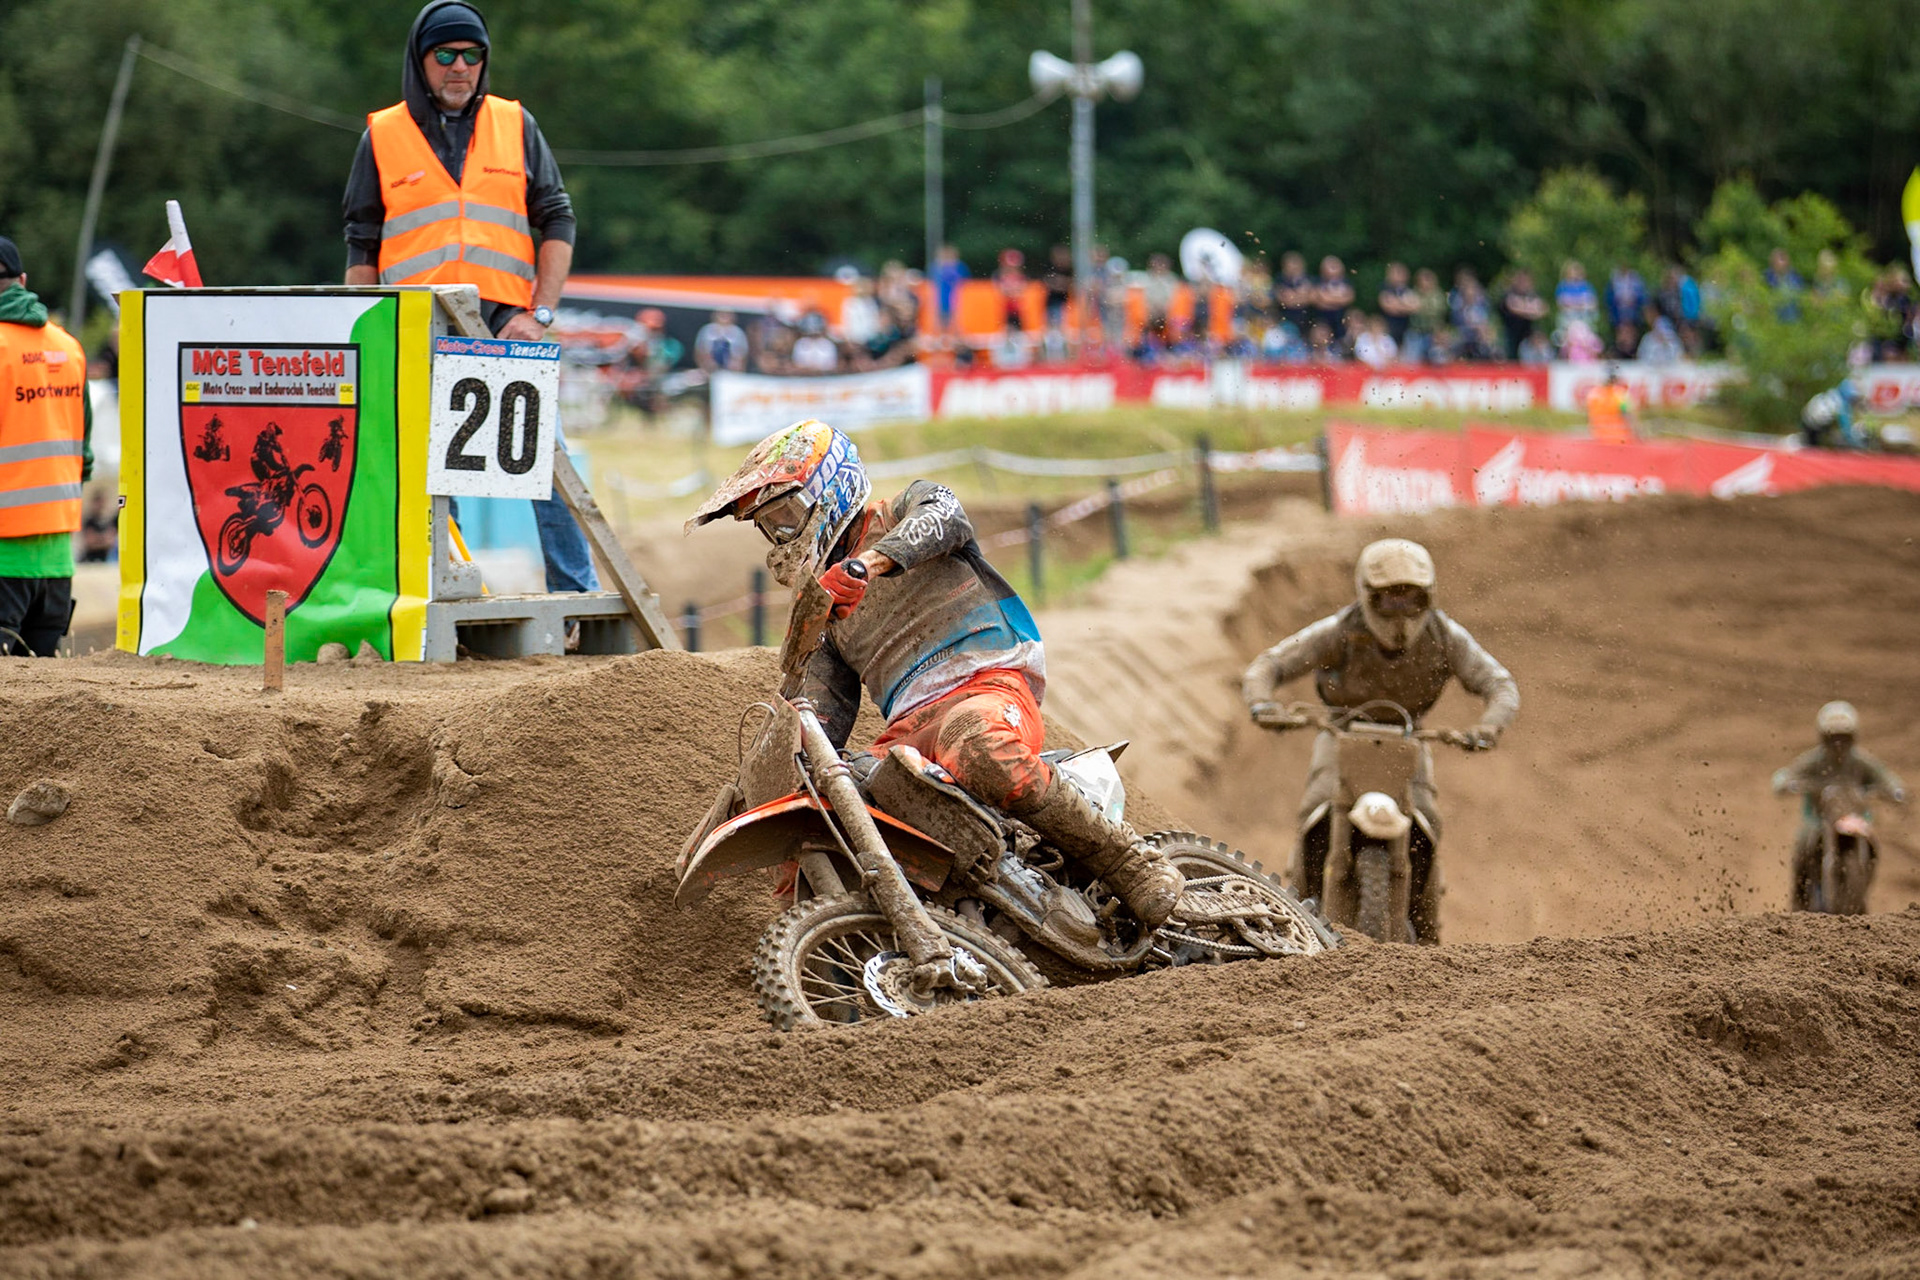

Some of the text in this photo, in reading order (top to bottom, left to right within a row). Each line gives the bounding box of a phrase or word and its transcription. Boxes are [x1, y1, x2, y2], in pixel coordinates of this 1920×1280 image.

[437, 339, 559, 358] Moto-Cross Tensfeld
[192, 350, 344, 376] MCE Tensfeld
[16, 383, 81, 403] Spotwart
[203, 382, 222, 395] Moto
[249, 383, 262, 395] und
[306, 383, 336, 396] Tensfeld
[445, 377, 540, 475] 20
[892, 645, 955, 697] DGESTONE
